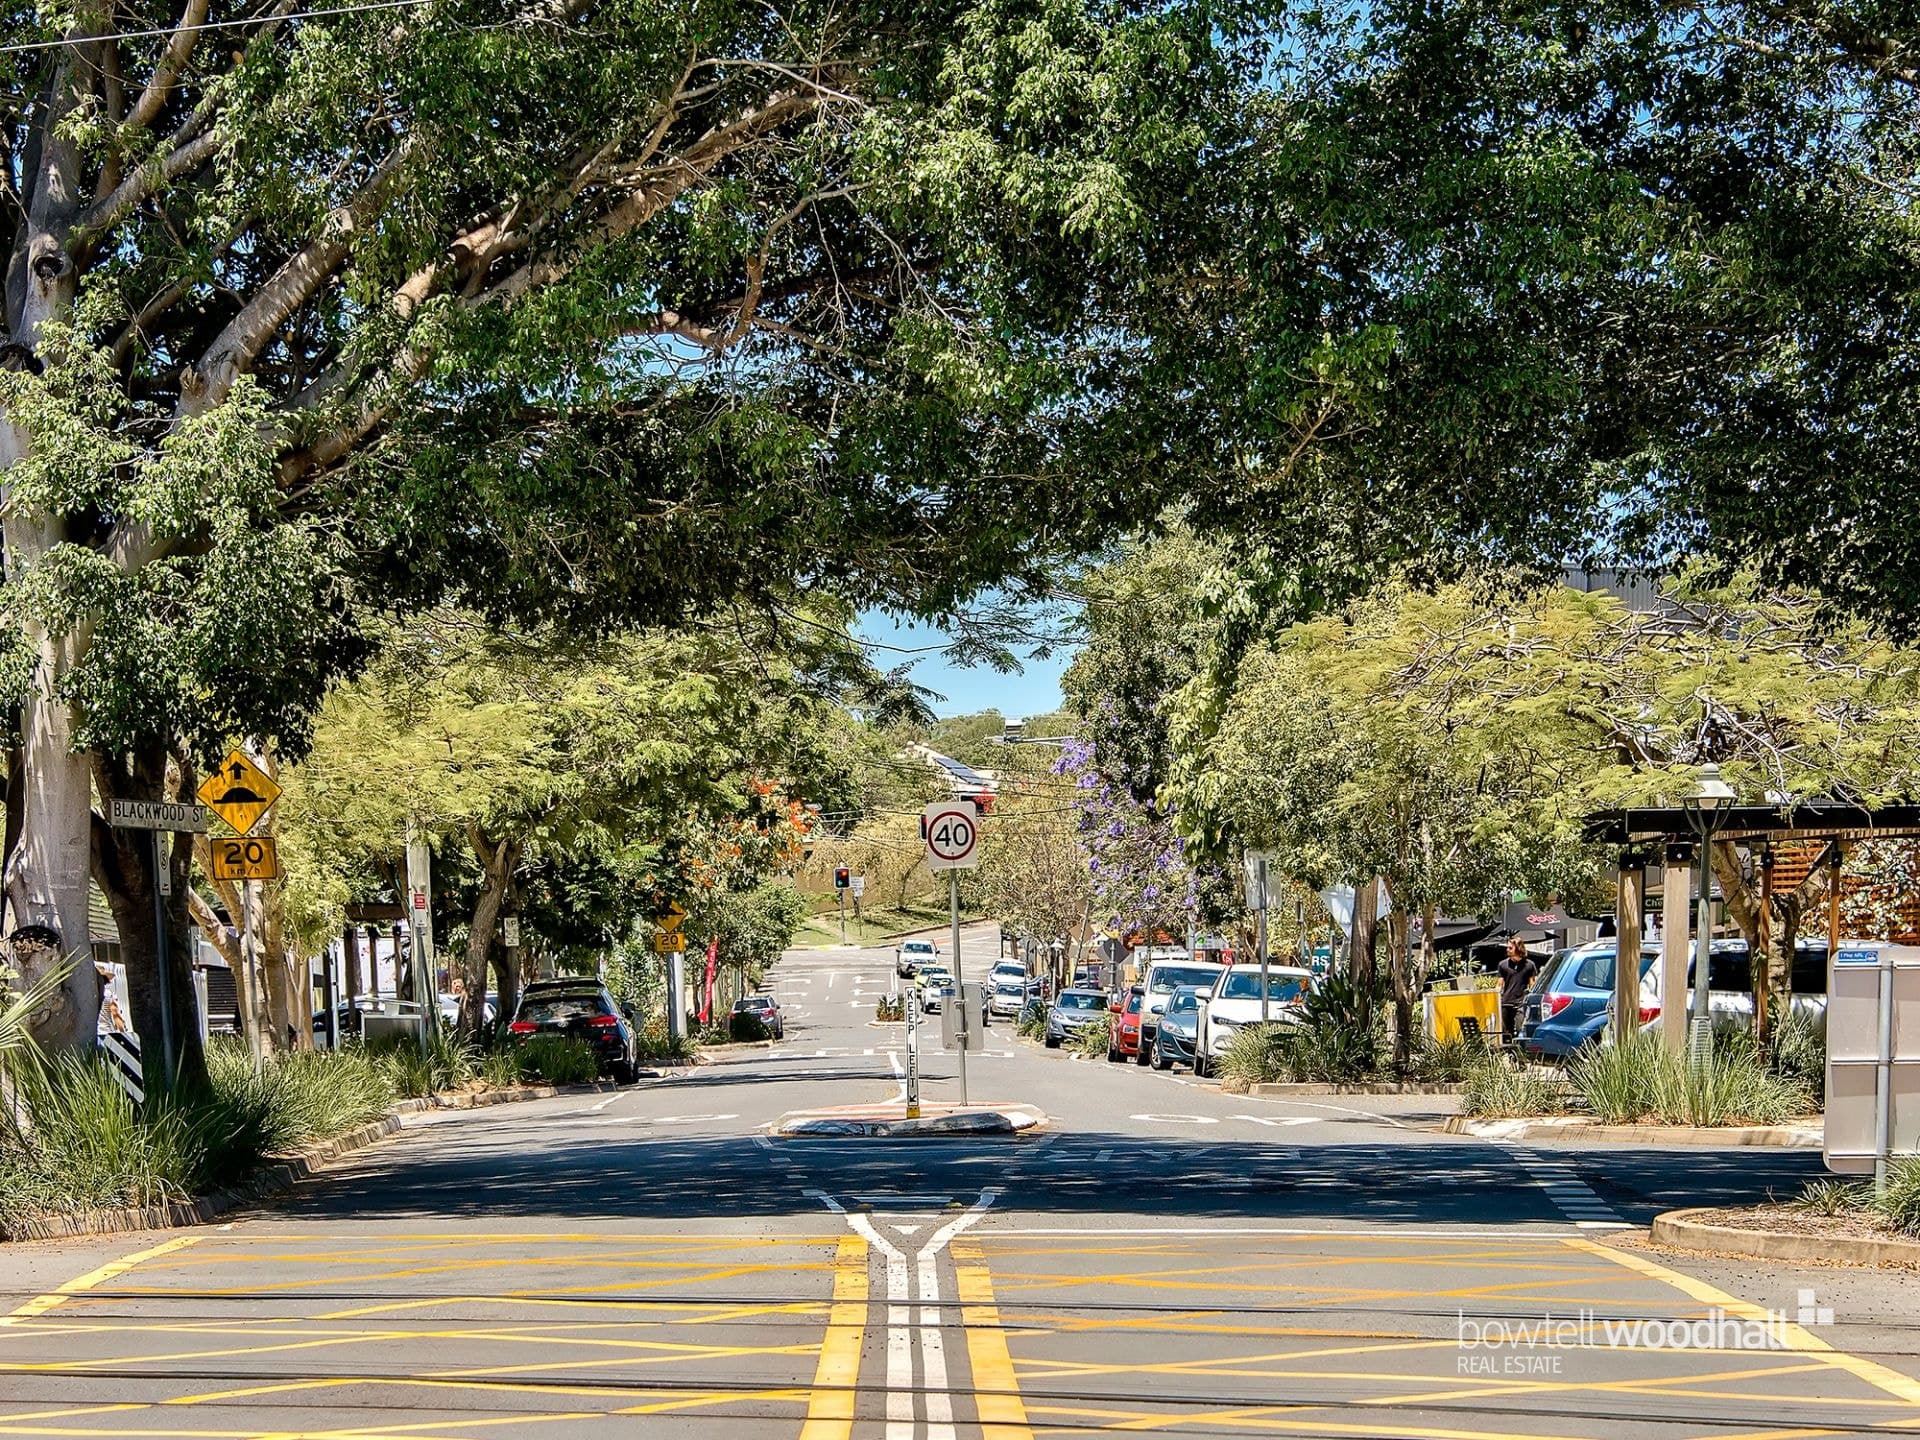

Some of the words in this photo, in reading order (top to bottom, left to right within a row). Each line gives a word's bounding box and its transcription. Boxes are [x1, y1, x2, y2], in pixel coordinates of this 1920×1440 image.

[113, 802, 185, 822] BLACKWOOD
[192, 807, 205, 823] ST
[934, 823, 969, 847] 40
[224, 842, 264, 865] 20
[230, 867, 261, 876] km/h
[661, 935, 679, 945] 20
[906, 989, 915, 1035] KEEP
[908, 1043, 916, 1088] LEFT
